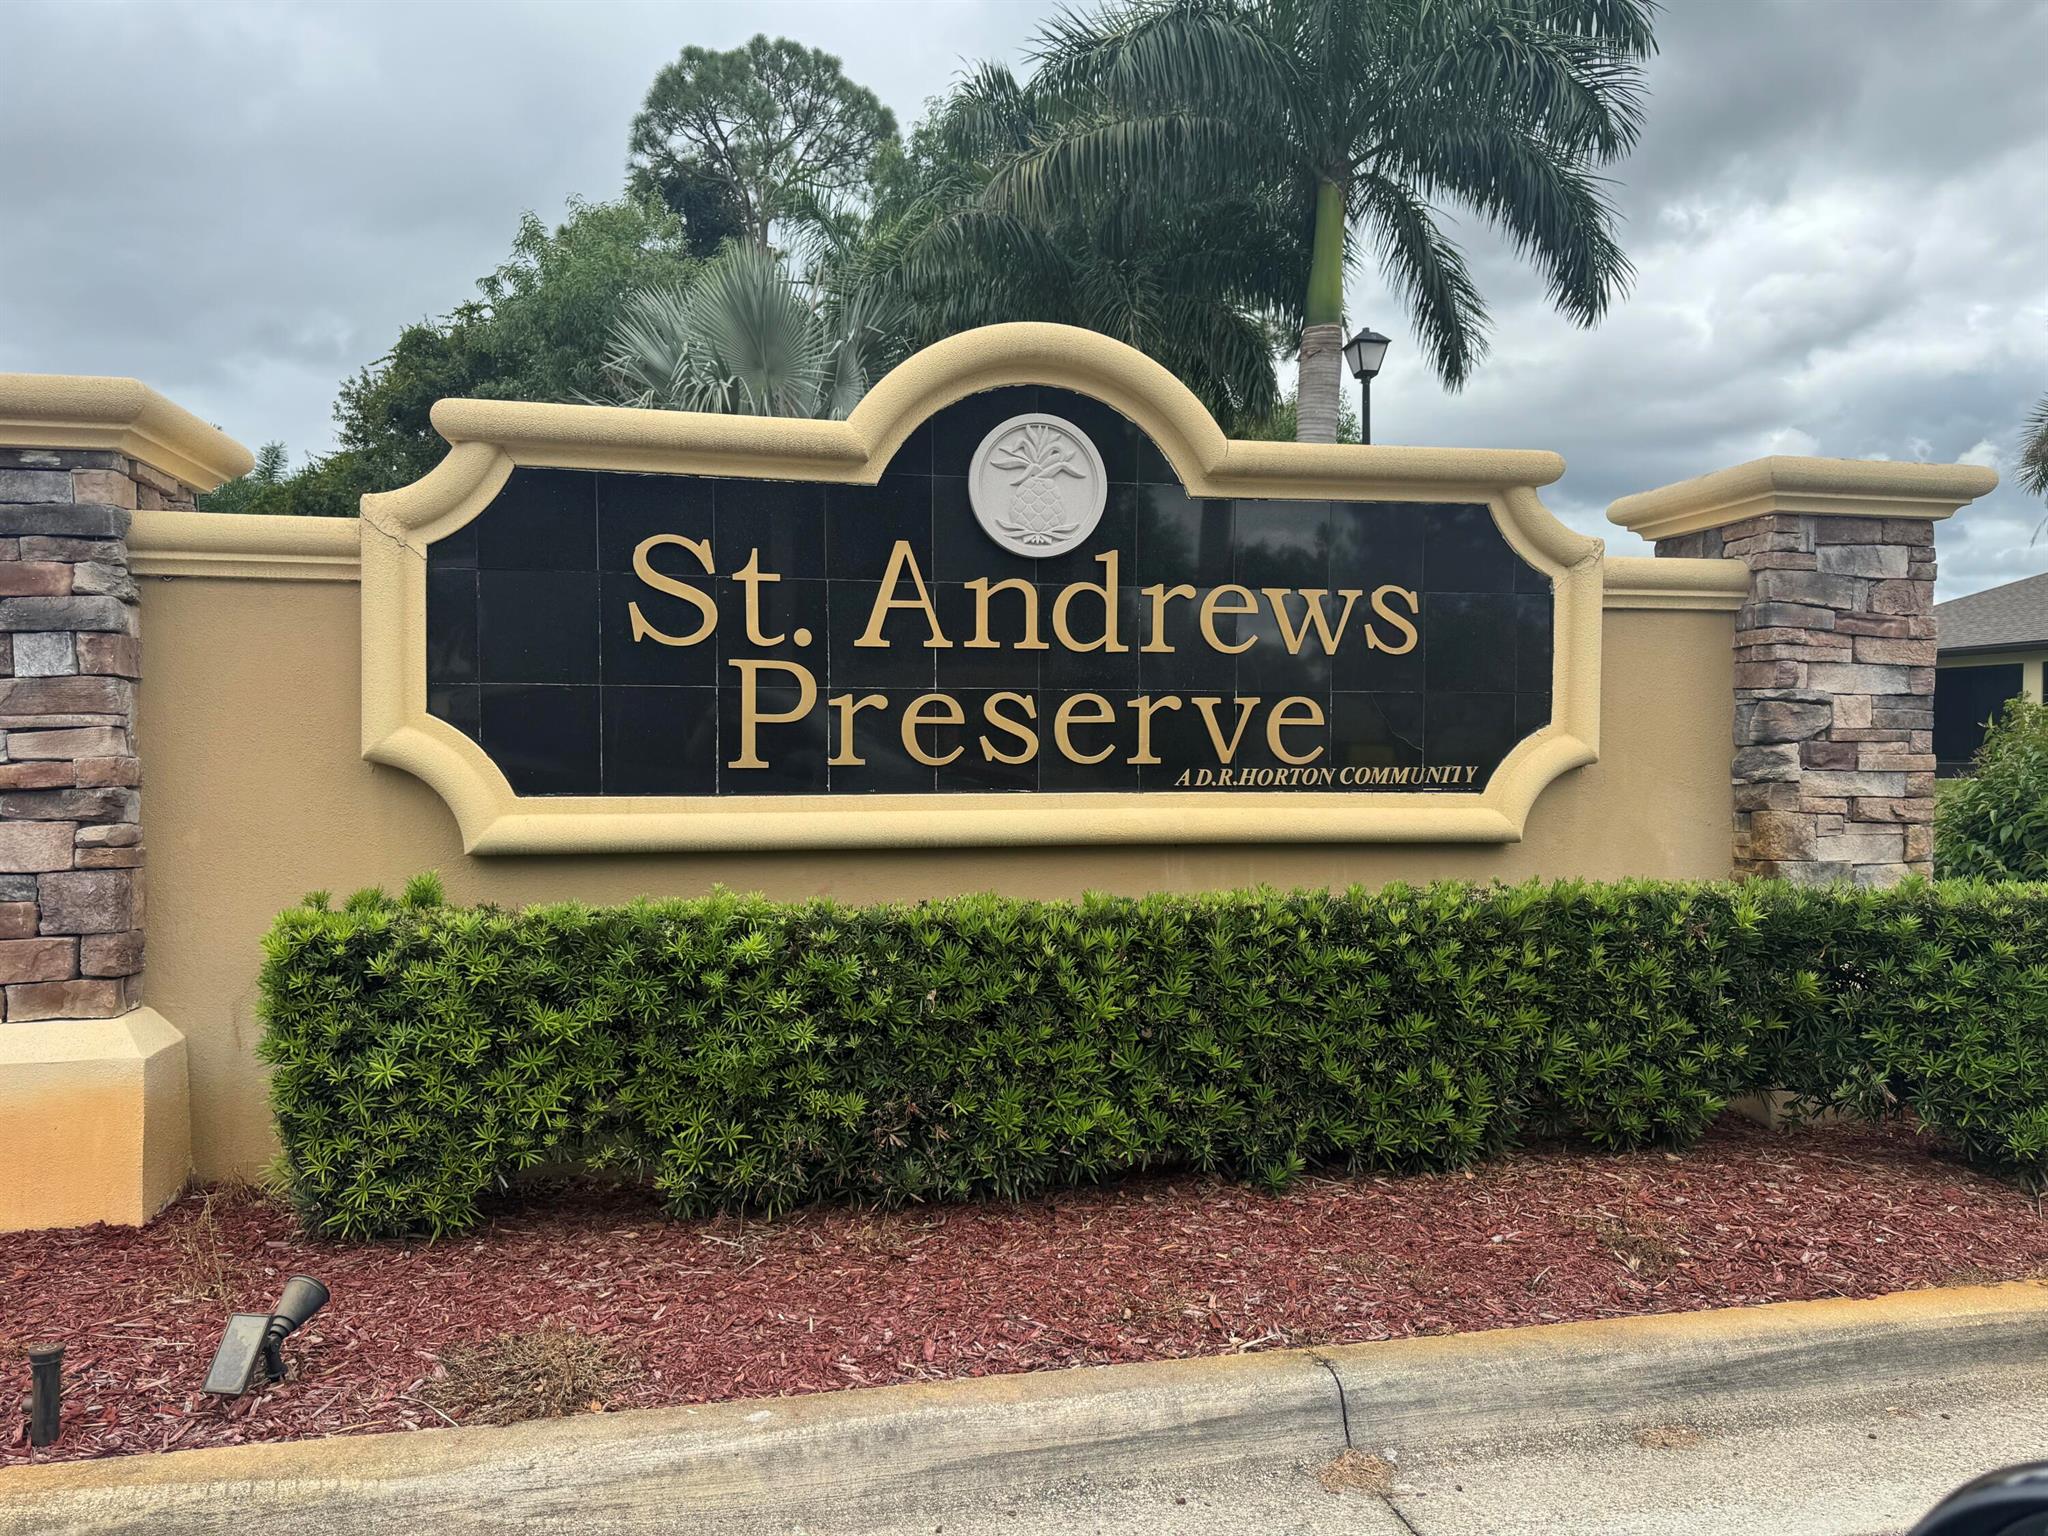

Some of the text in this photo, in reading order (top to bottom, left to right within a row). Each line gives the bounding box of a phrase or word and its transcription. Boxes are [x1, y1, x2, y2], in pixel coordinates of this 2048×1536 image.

[628, 533, 1420, 656] St. Andrews
[727, 658, 1326, 770] Preserve
[1339, 765, 1479, 785] COMMUNITY
